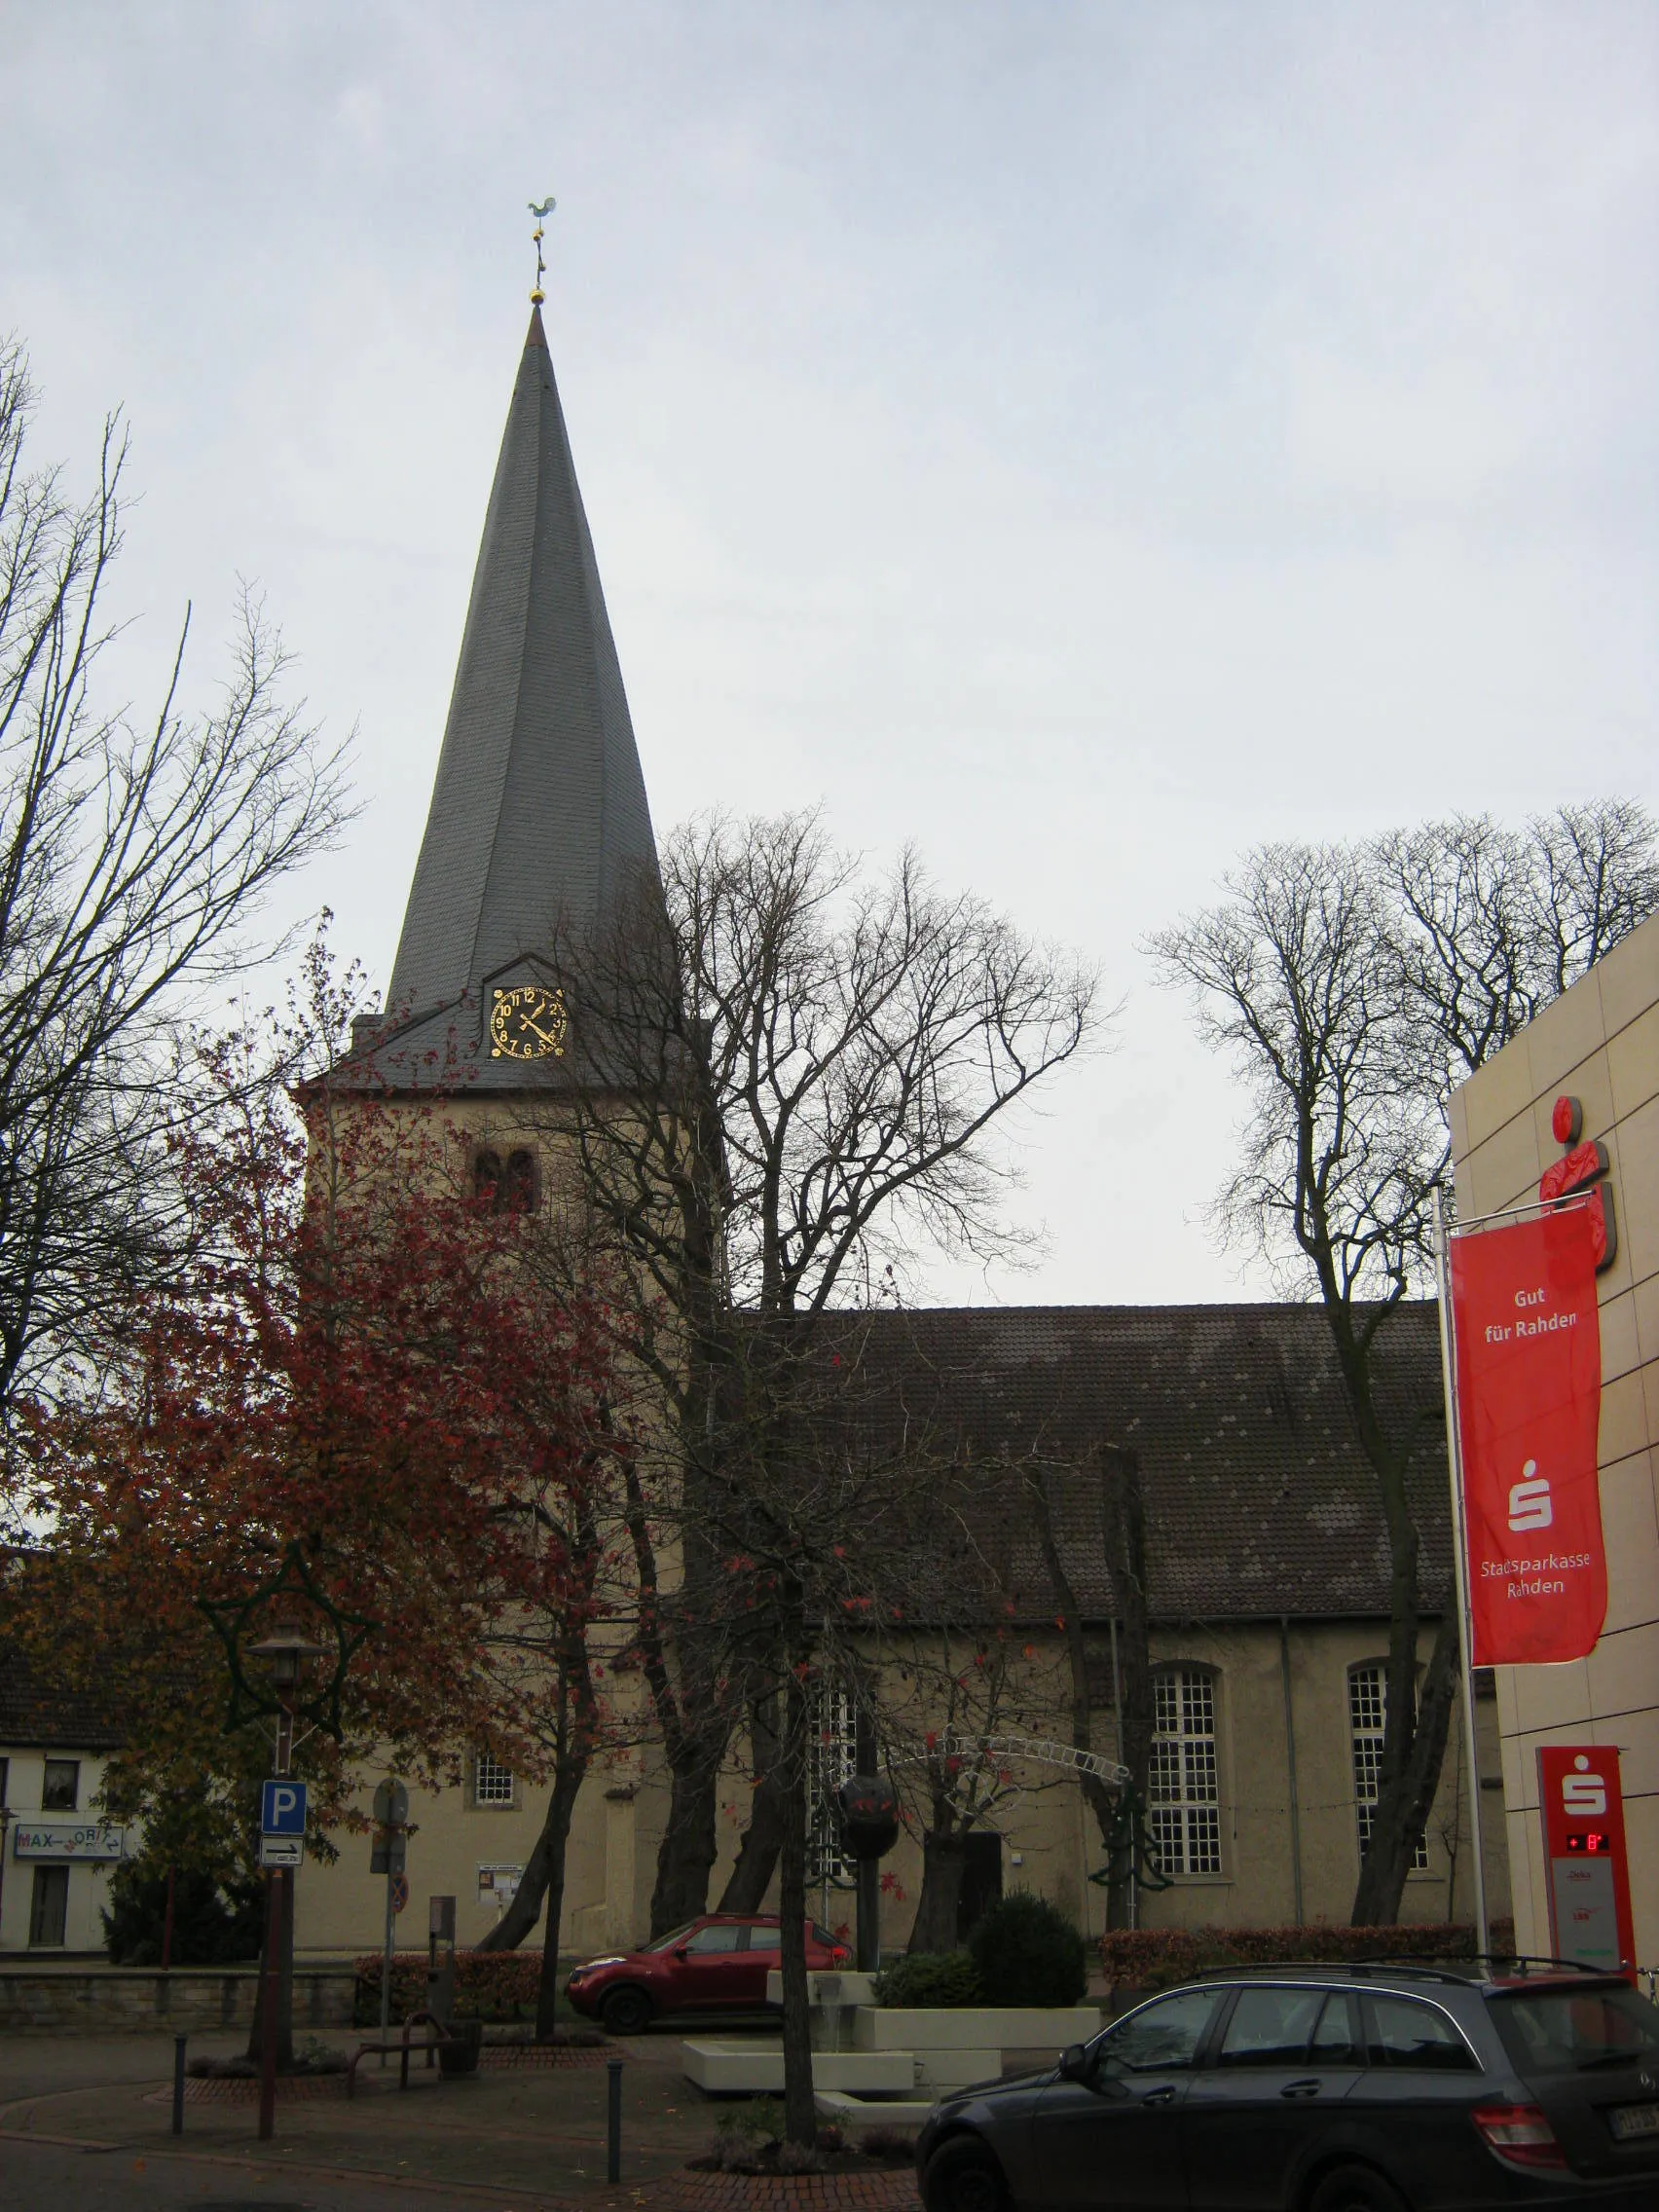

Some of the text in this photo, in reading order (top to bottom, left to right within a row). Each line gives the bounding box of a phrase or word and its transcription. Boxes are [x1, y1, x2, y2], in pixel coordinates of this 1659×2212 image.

[512, 995, 520, 1007] 11
[524, 991, 535, 1003] 12
[499, 1005, 511, 1016] 10
[549, 1004, 557, 1014] 2
[496, 1017, 504, 1028] 9
[499, 1030, 507, 1042] 8
[510, 1040, 518, 1051] 7
[524, 1044, 532, 1054] 6
[538, 1040, 546, 1051] 5
[1514, 1287, 1546, 1307] Gut
[1484, 1312, 1576, 1343] für Rahden
[1480, 1553, 1590, 1577] Stadsparkasse
[1507, 1578, 1565, 1599] Rahden
[272, 1787, 297, 1827] P
